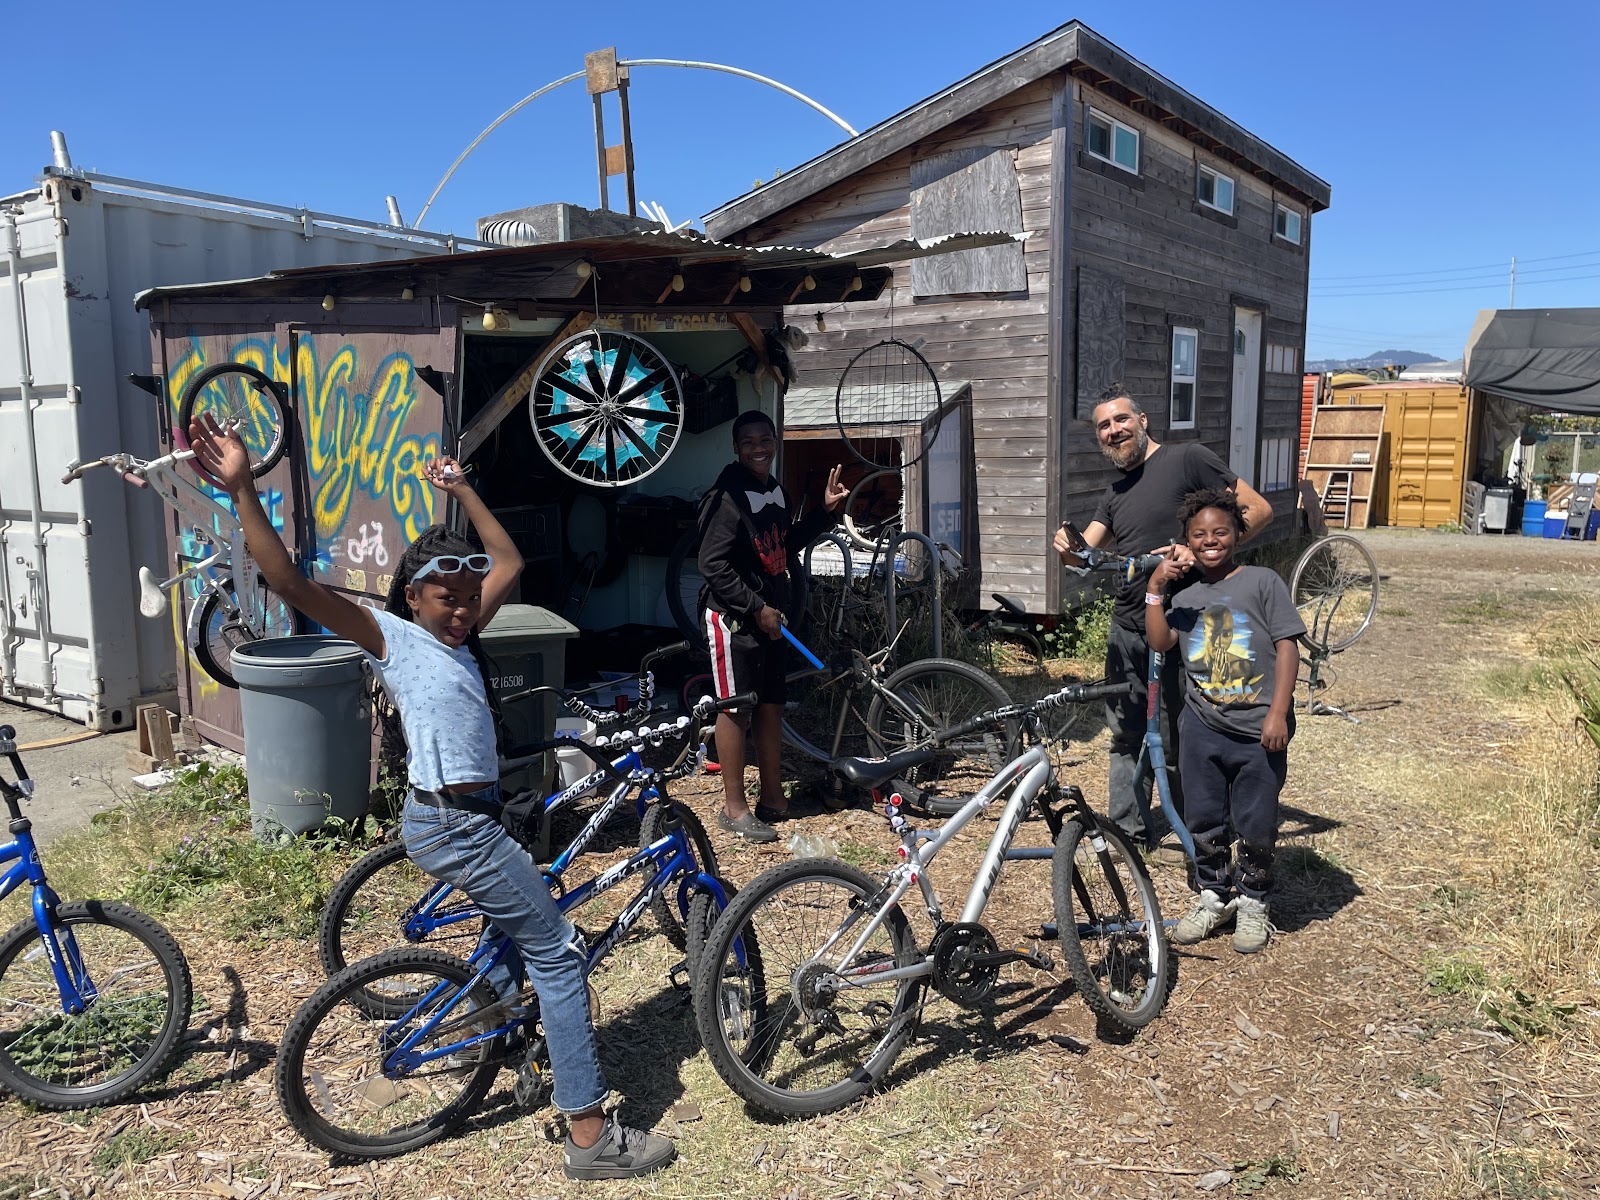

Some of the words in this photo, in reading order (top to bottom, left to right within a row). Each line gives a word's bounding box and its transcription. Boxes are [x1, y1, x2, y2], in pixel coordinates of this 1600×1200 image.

[630, 313, 658, 332] THE
[672, 312, 717, 331] TOOLS
[563, 777, 592, 803] ROCK
[593, 769, 606, 781] IT
[982, 794, 1028, 898] HUFFY
[590, 869, 627, 898] ROCK
[631, 857, 648, 870] IT
[604, 886, 654, 949] HUFFY
[42, 933, 57, 963] HUFFY
